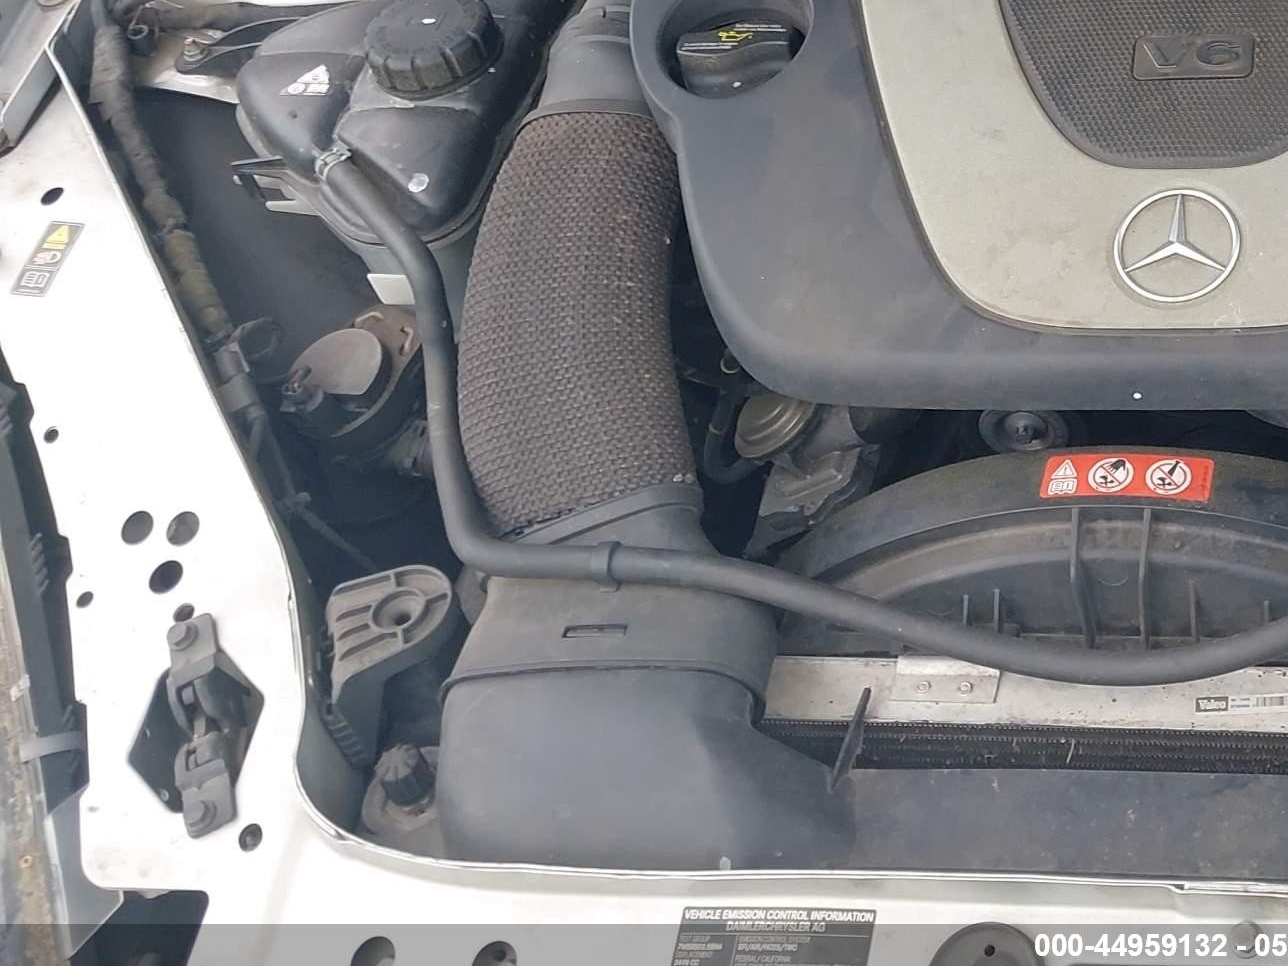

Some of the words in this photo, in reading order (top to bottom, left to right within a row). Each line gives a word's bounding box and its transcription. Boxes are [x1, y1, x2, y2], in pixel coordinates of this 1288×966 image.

[1142, 40, 1241, 69] V6
[685, 909, 721, 920] VEHICLE
[722, 909, 765, 921] EMISSION
[766, 910, 809, 921] CONTROL
[811, 910, 875, 923] INFORMATION
[725, 921, 810, 932] DAIMLERCHRYSLER
[811, 922, 826, 933] AG
